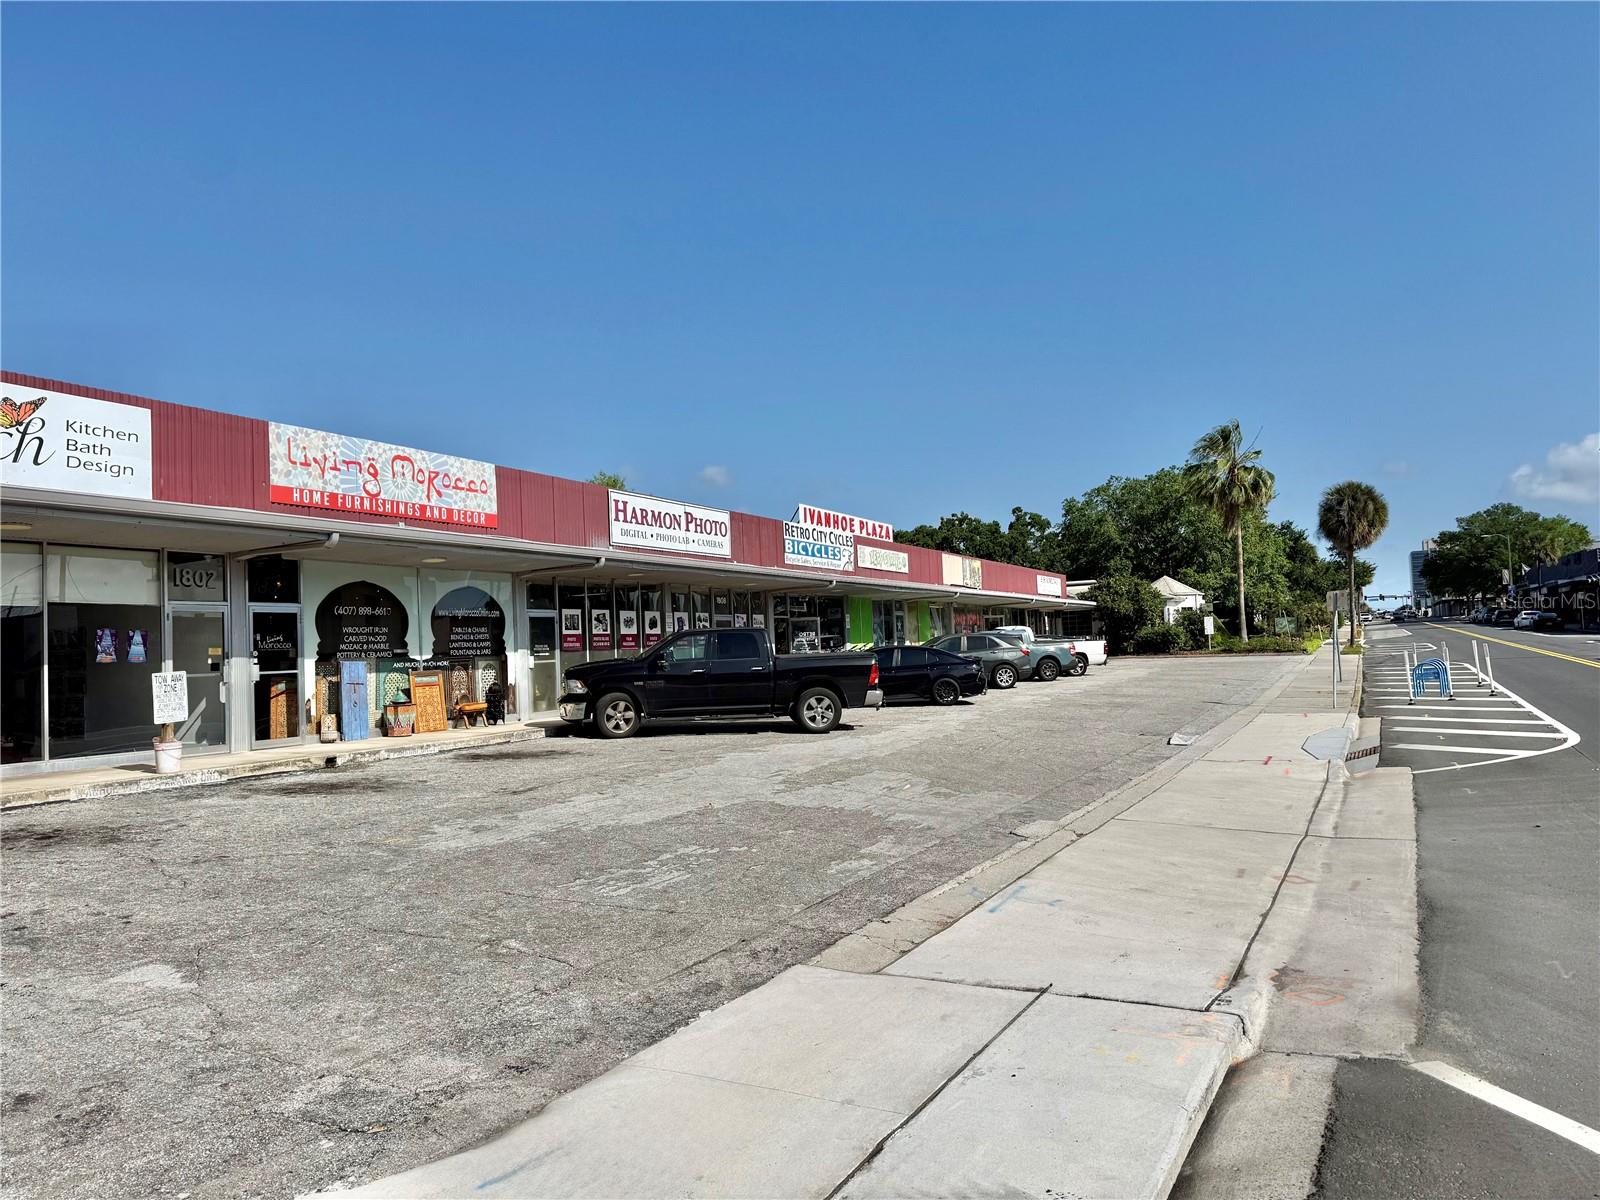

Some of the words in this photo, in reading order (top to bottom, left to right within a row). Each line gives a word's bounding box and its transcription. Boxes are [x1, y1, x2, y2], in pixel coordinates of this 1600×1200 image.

[66, 419, 139, 443] Kitchen
[66, 438, 112, 457] Bath
[66, 455, 134, 478] Design
[287, 437, 382, 498] Living
[293, 488, 330, 506] HOME
[337, 494, 420, 517] FURNISHINGS
[425, 505, 447, 520] AND
[453, 510, 485, 525] DECOR
[613, 499, 682, 531] HARMON
[684, 511, 728, 538] PHOTO
[803, 507, 855, 533] IVANHOE
[860, 521, 891, 540] PLAZA
[620, 528, 648, 540] DIGITAL
[655, 532, 678, 544] PHOTO
[678, 535, 690, 545] LAB
[697, 538, 724, 549] CAMERAS
[784, 522, 810, 540] RETRO
[812, 528, 827, 544] CITY
[829, 531, 854, 548] CYCLES
[785, 540, 841, 560] BICYCLES
[173, 567, 217, 590] 1802
[334, 605, 357, 615] (407)
[258, 641, 292, 649] Morocco
[336, 651, 361, 659] POTTERY
[366, 650, 393, 658] CERAMICS
[154, 674, 168, 684] TOW
[163, 683, 177, 693] ZONE
